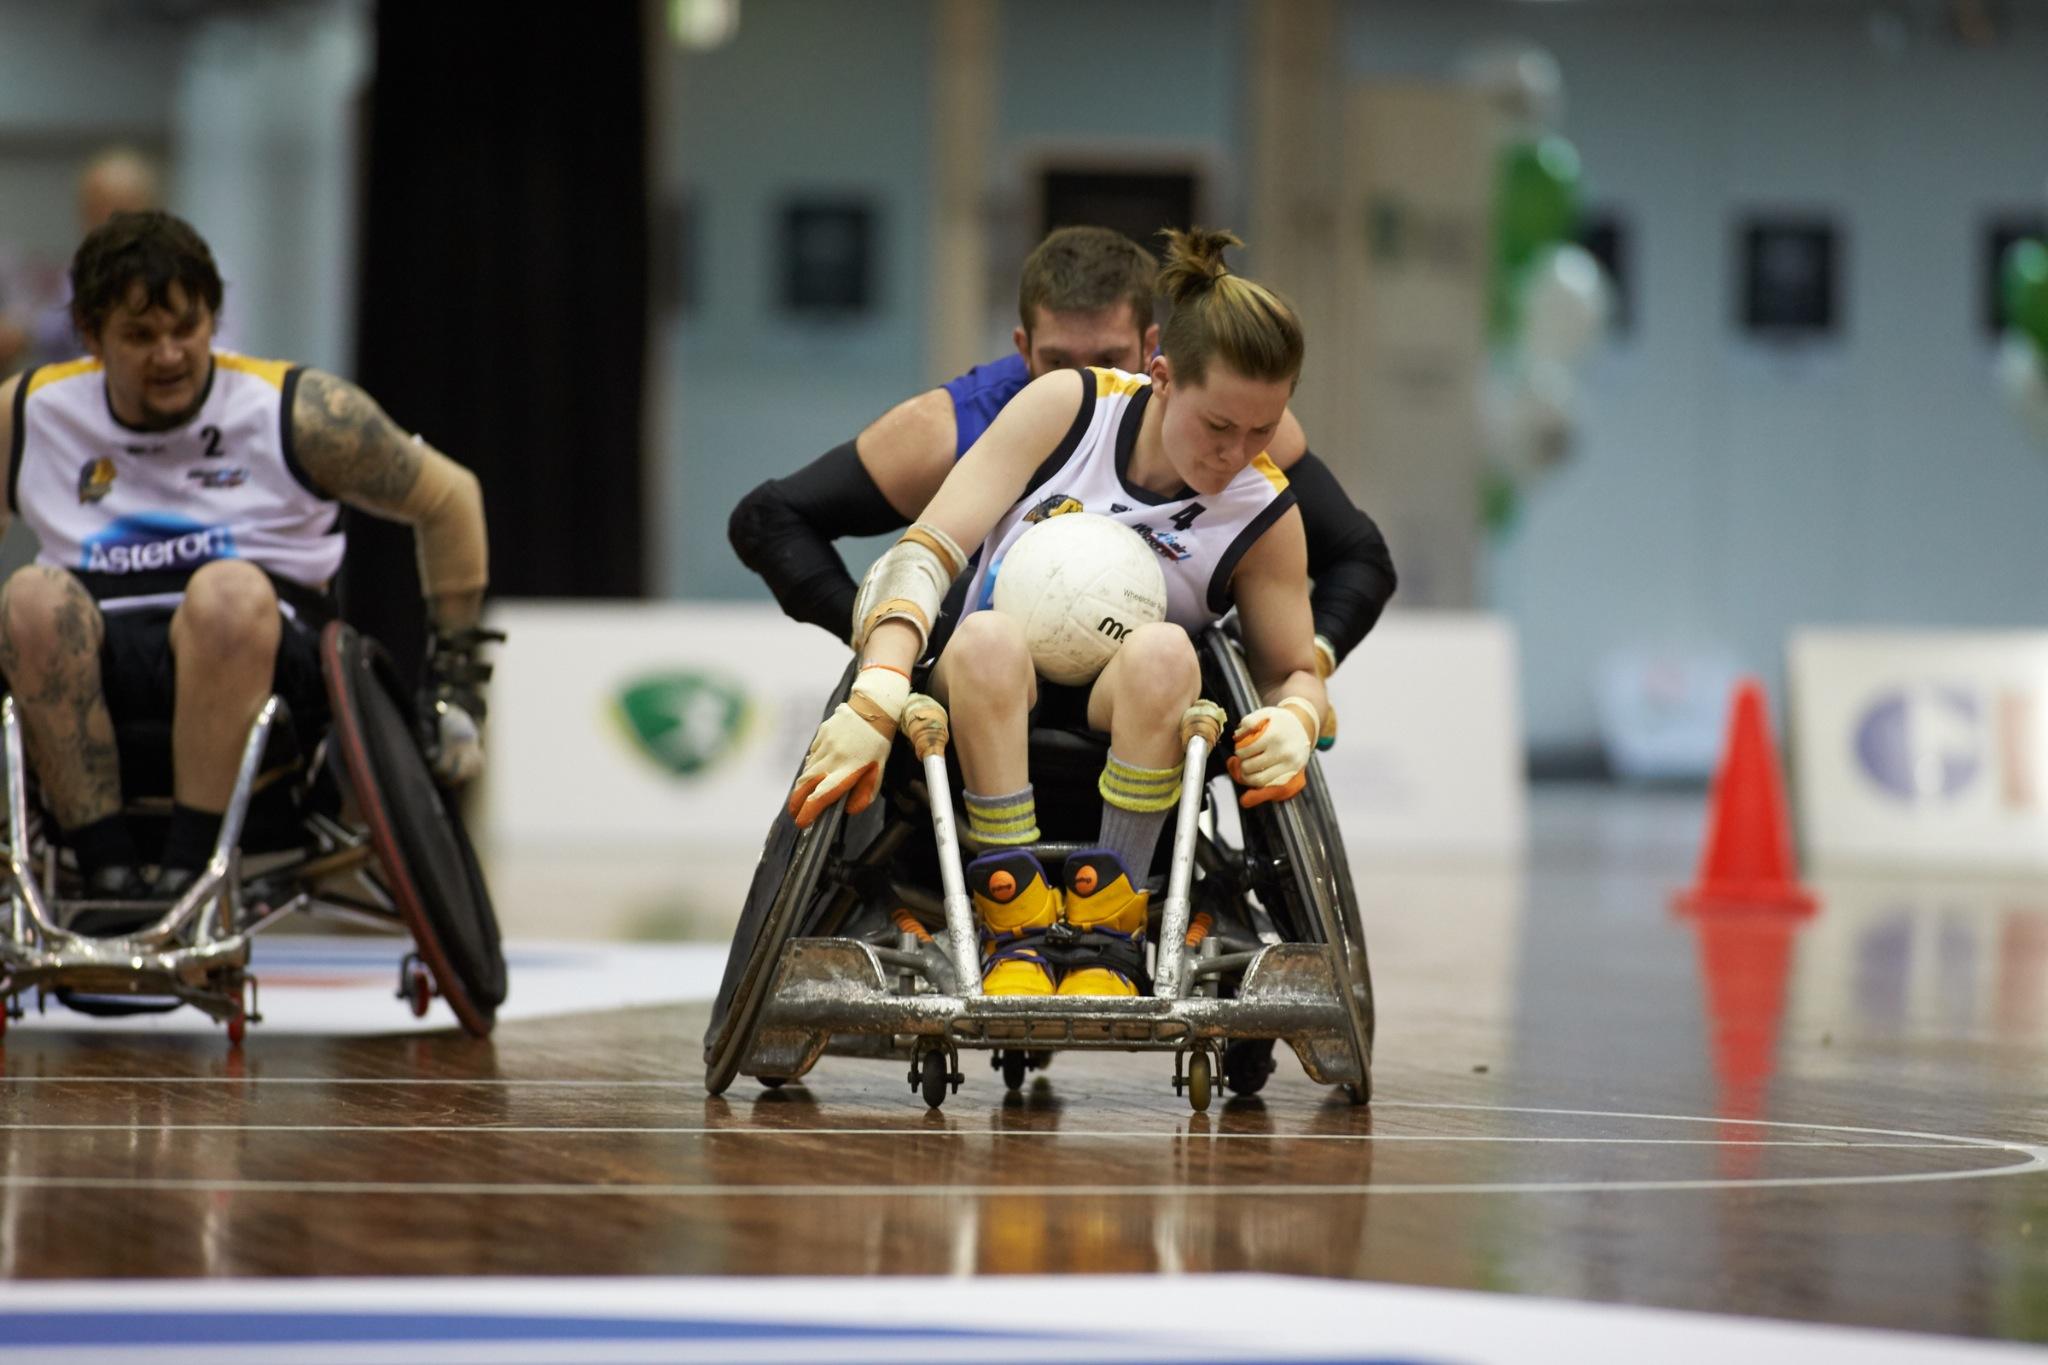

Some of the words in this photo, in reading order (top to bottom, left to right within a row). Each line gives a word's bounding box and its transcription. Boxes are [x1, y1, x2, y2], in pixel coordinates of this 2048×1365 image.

[200, 424, 224, 458] 2
[1169, 501, 1207, 531] 4
[89, 527, 227, 574] Asteron
